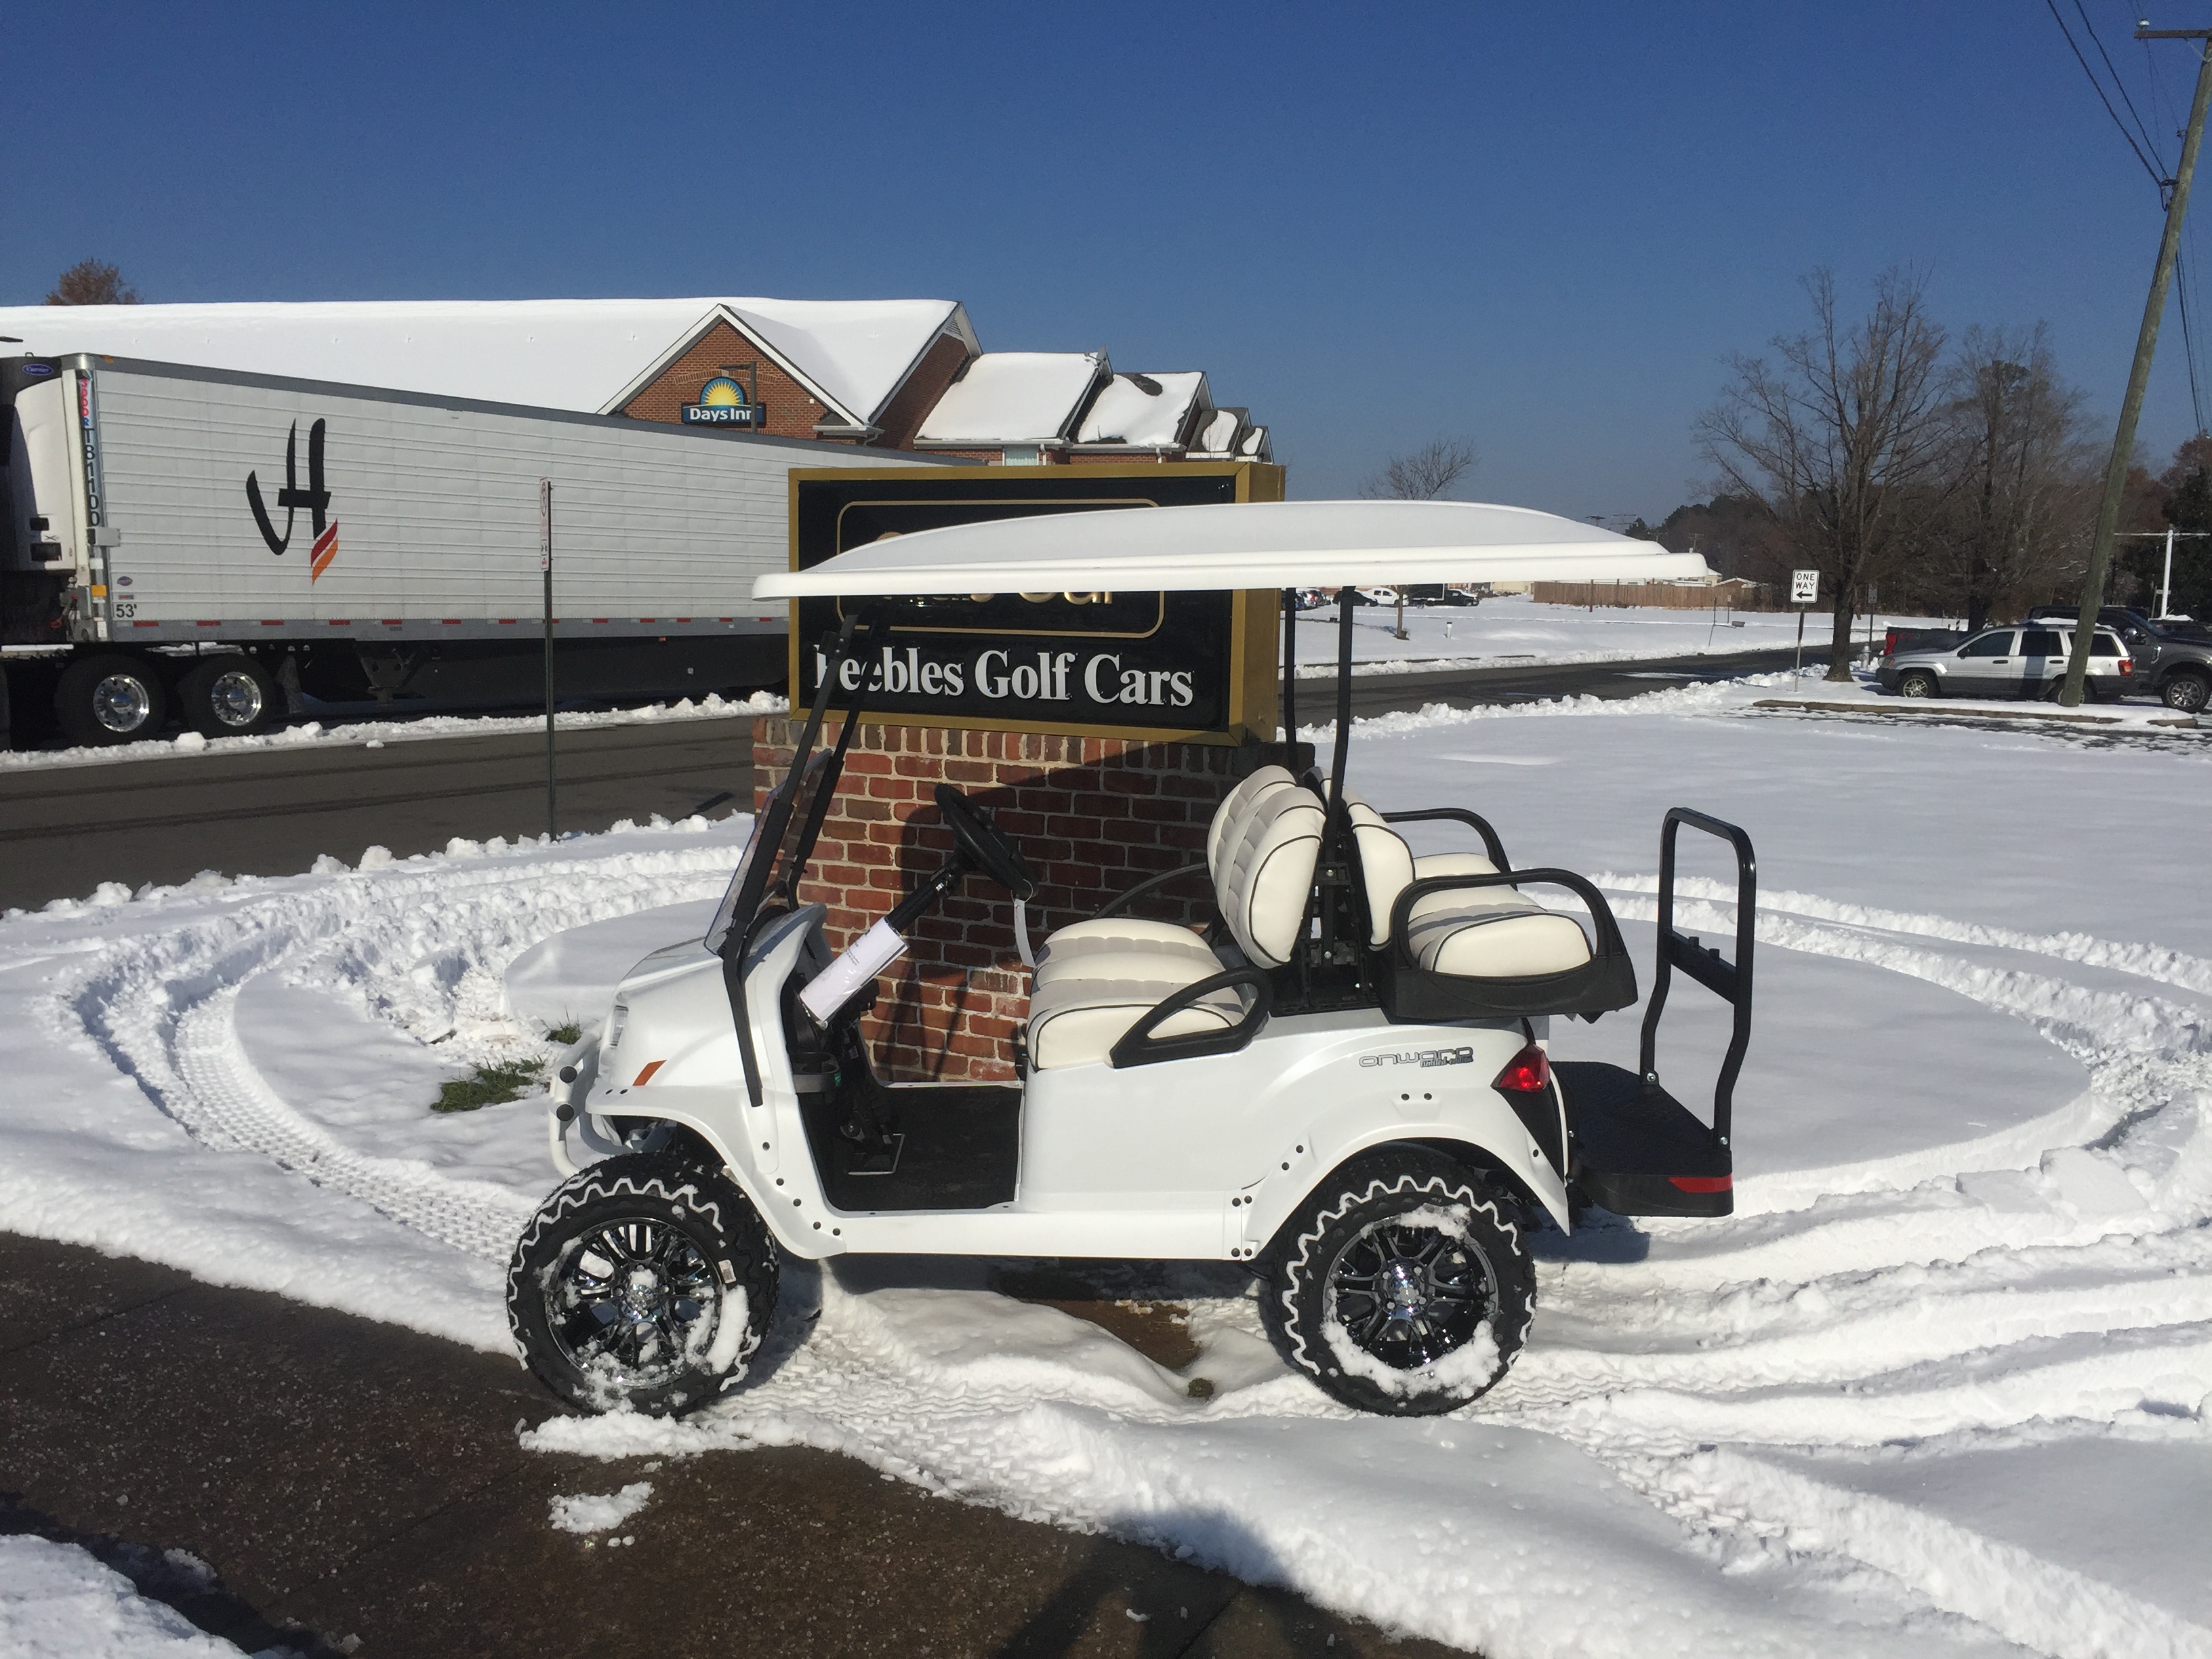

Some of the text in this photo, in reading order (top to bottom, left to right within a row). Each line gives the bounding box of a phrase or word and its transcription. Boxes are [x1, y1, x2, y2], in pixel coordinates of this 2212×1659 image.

[690, 408, 728, 422] Days
[1797, 573, 1815, 581] ONE
[975, 650, 1076, 700] Golf
[1084, 654, 1193, 706] Cars
